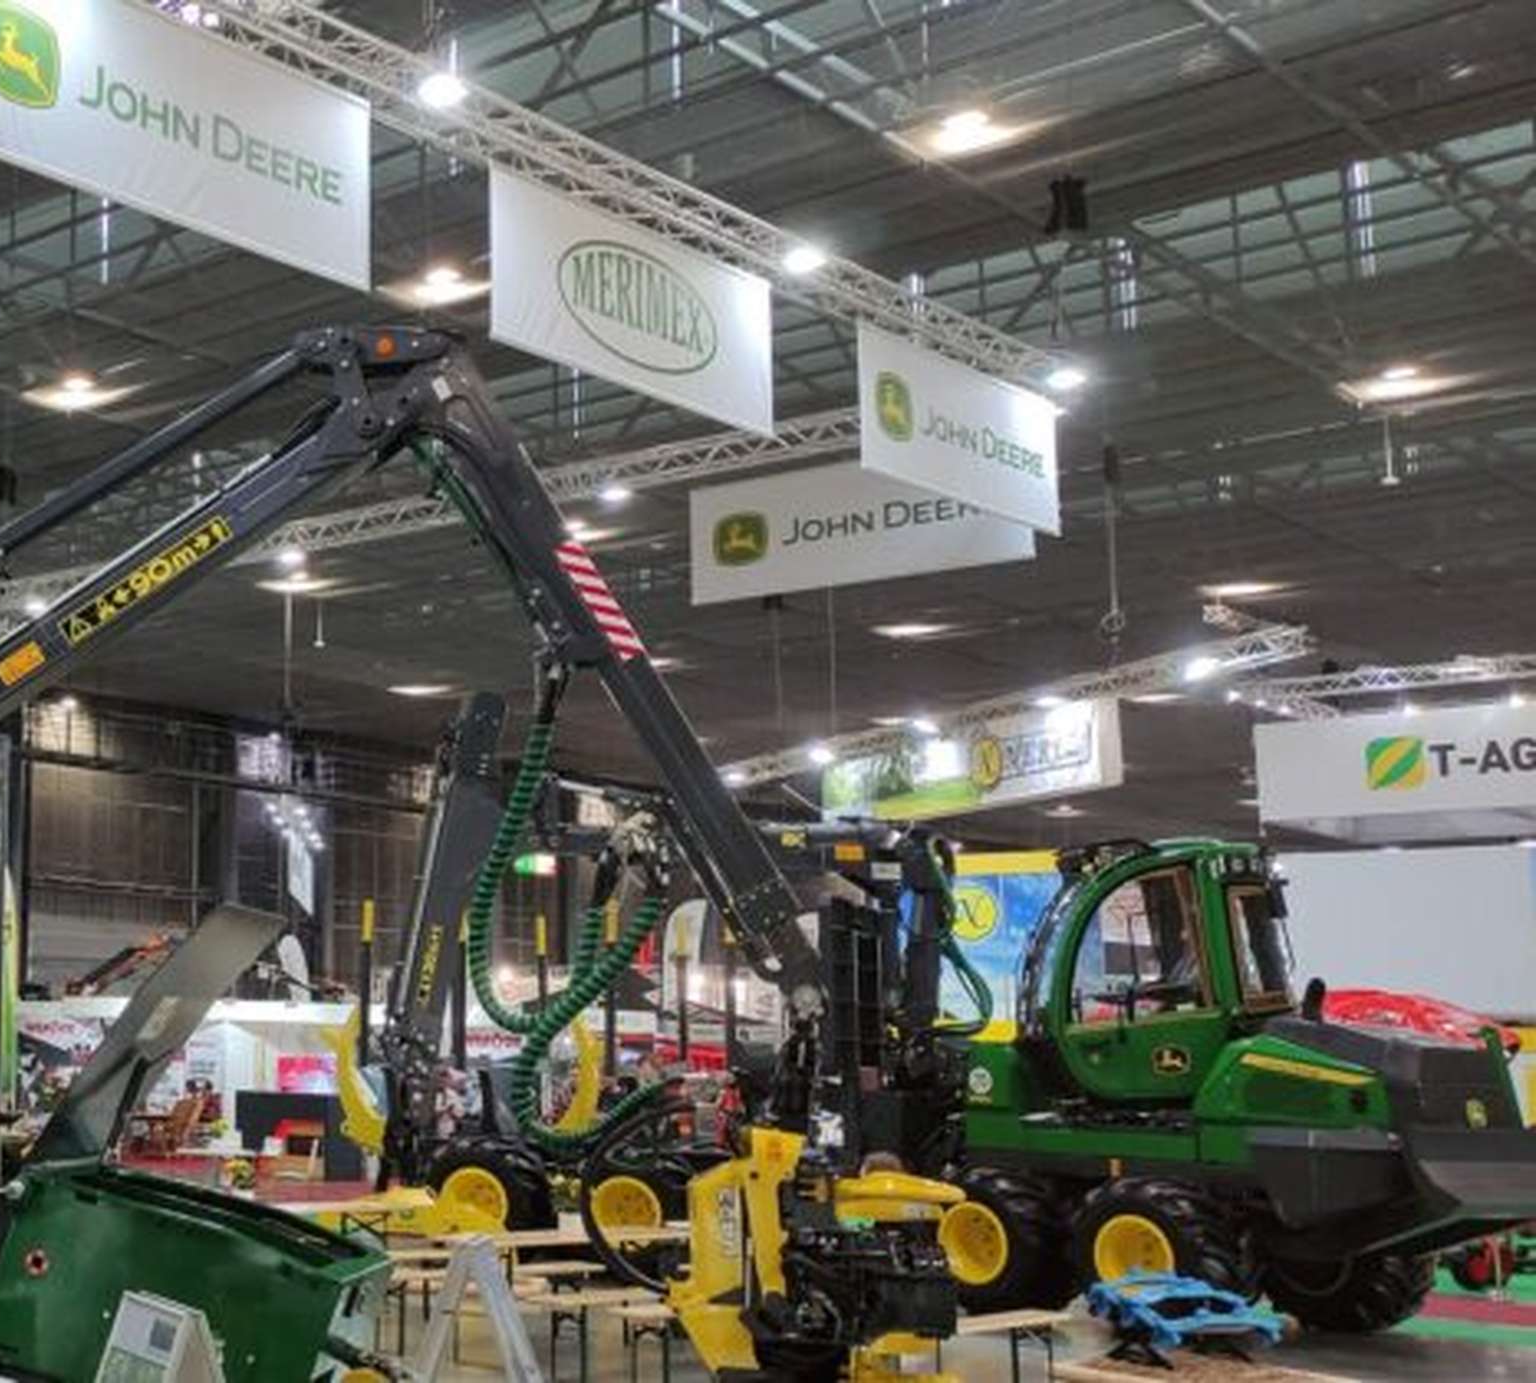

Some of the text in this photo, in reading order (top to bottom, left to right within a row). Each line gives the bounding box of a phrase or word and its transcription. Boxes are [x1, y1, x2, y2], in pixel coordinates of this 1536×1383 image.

[79, 66, 342, 204] JOHN DEERE
[571, 251, 704, 354] MERIMEX
[923, 404, 1045, 478] JOHN DEERE
[781, 511, 875, 546] JOHN
